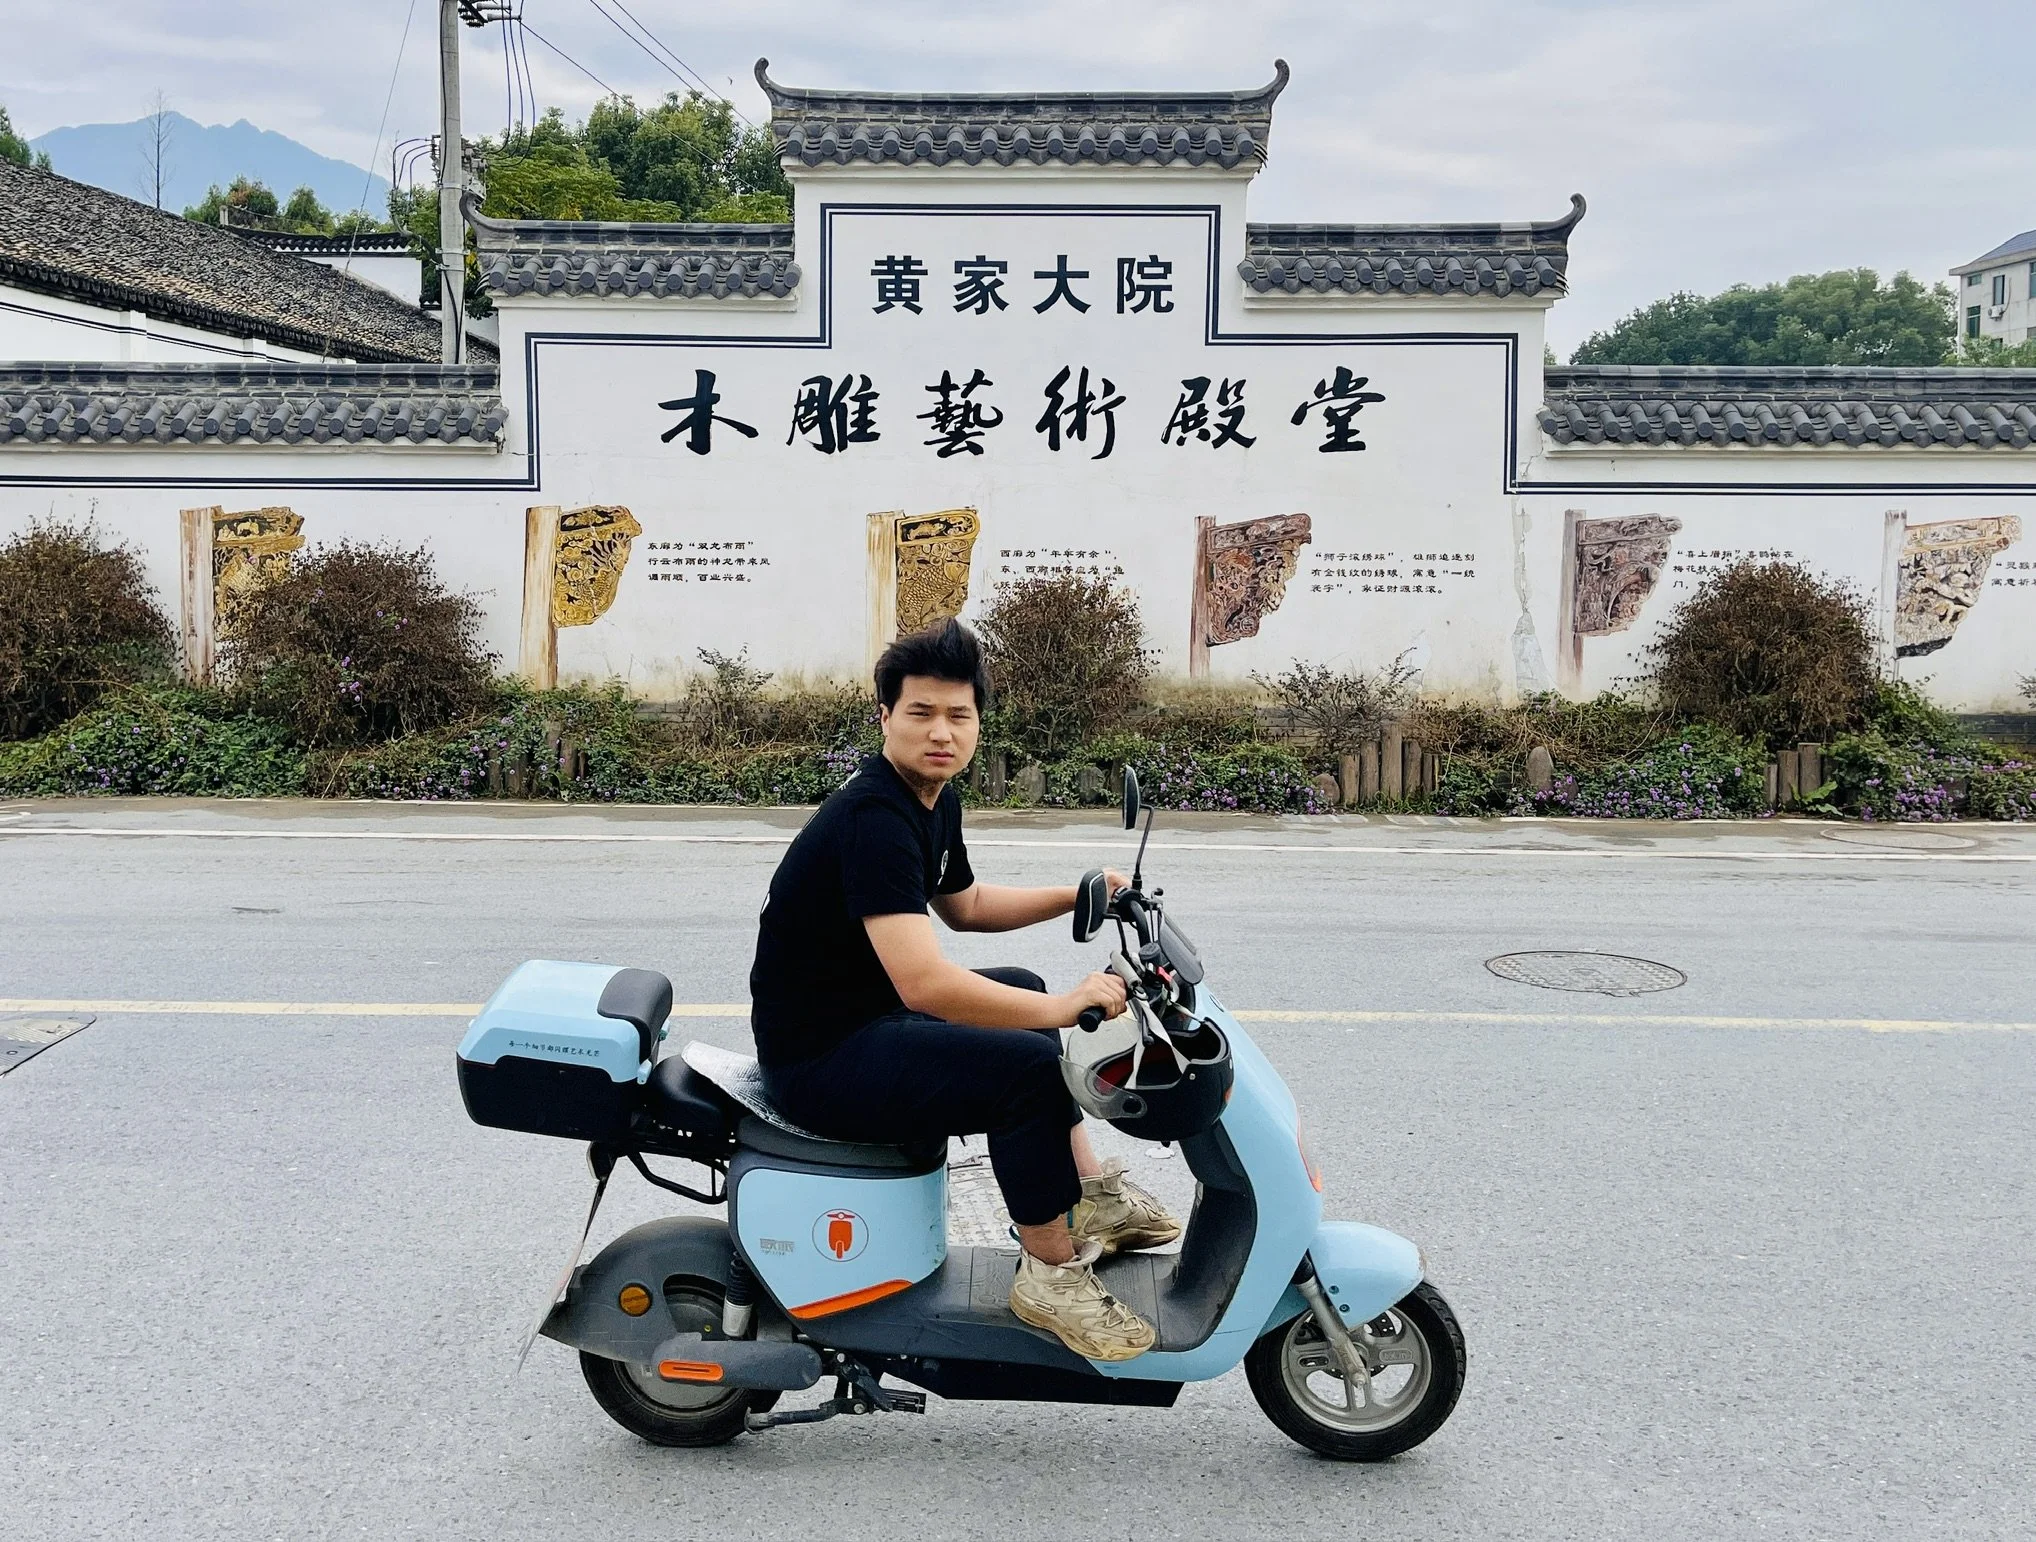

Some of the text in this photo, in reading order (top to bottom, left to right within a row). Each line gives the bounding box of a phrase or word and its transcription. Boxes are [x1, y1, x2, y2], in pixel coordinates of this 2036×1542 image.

[871, 255, 1174, 315] 黄家大院
[658, 365, 1386, 460] 木雕藝術殿堂
